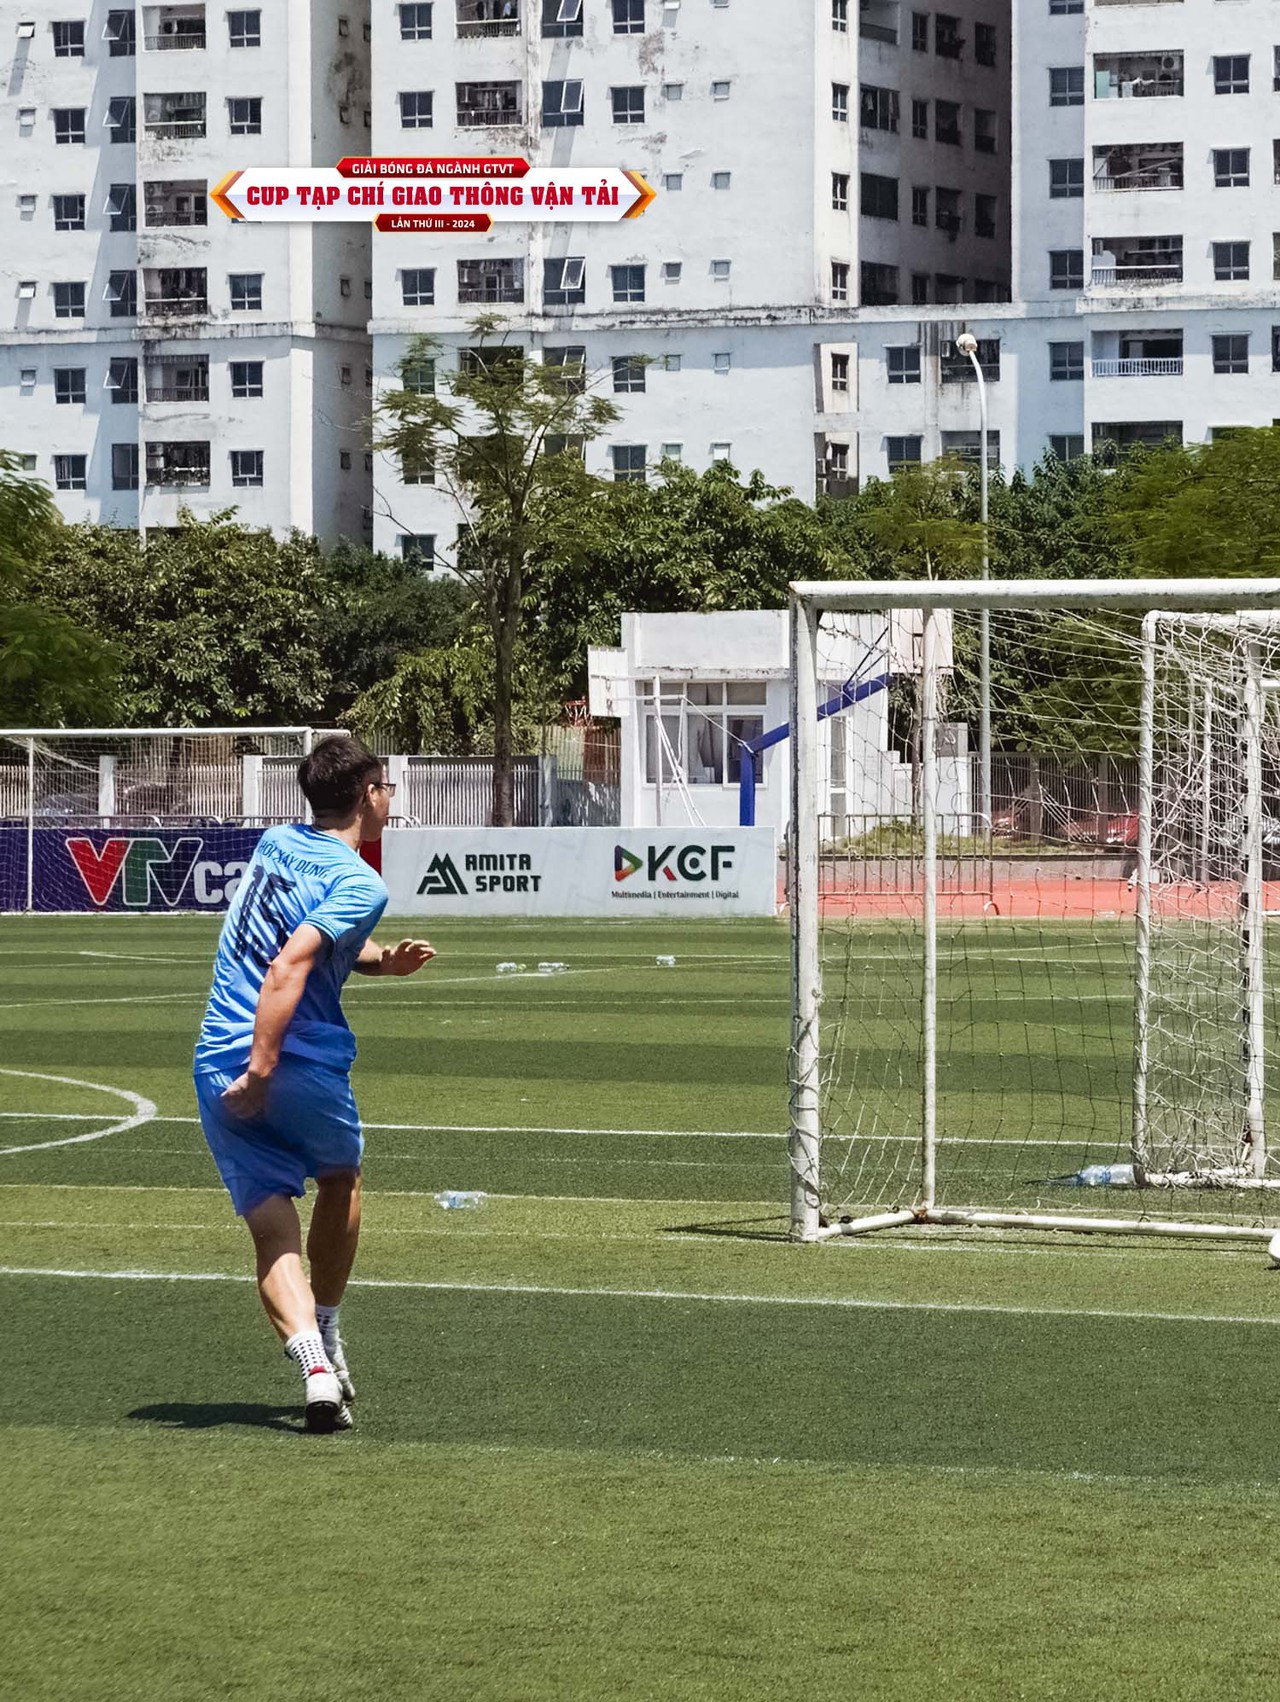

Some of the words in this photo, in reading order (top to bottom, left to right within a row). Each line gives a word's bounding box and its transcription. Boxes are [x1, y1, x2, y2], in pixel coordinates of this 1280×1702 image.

[65, 837, 250, 906] VTVca
[464, 854, 532, 871] AMITA
[647, 844, 736, 882] KCF
[475, 874, 542, 892] SPORT
[611, 890, 652, 899] Multimedia
[657, 890, 710, 899] Entertainment
[715, 890, 740, 900] Digital
